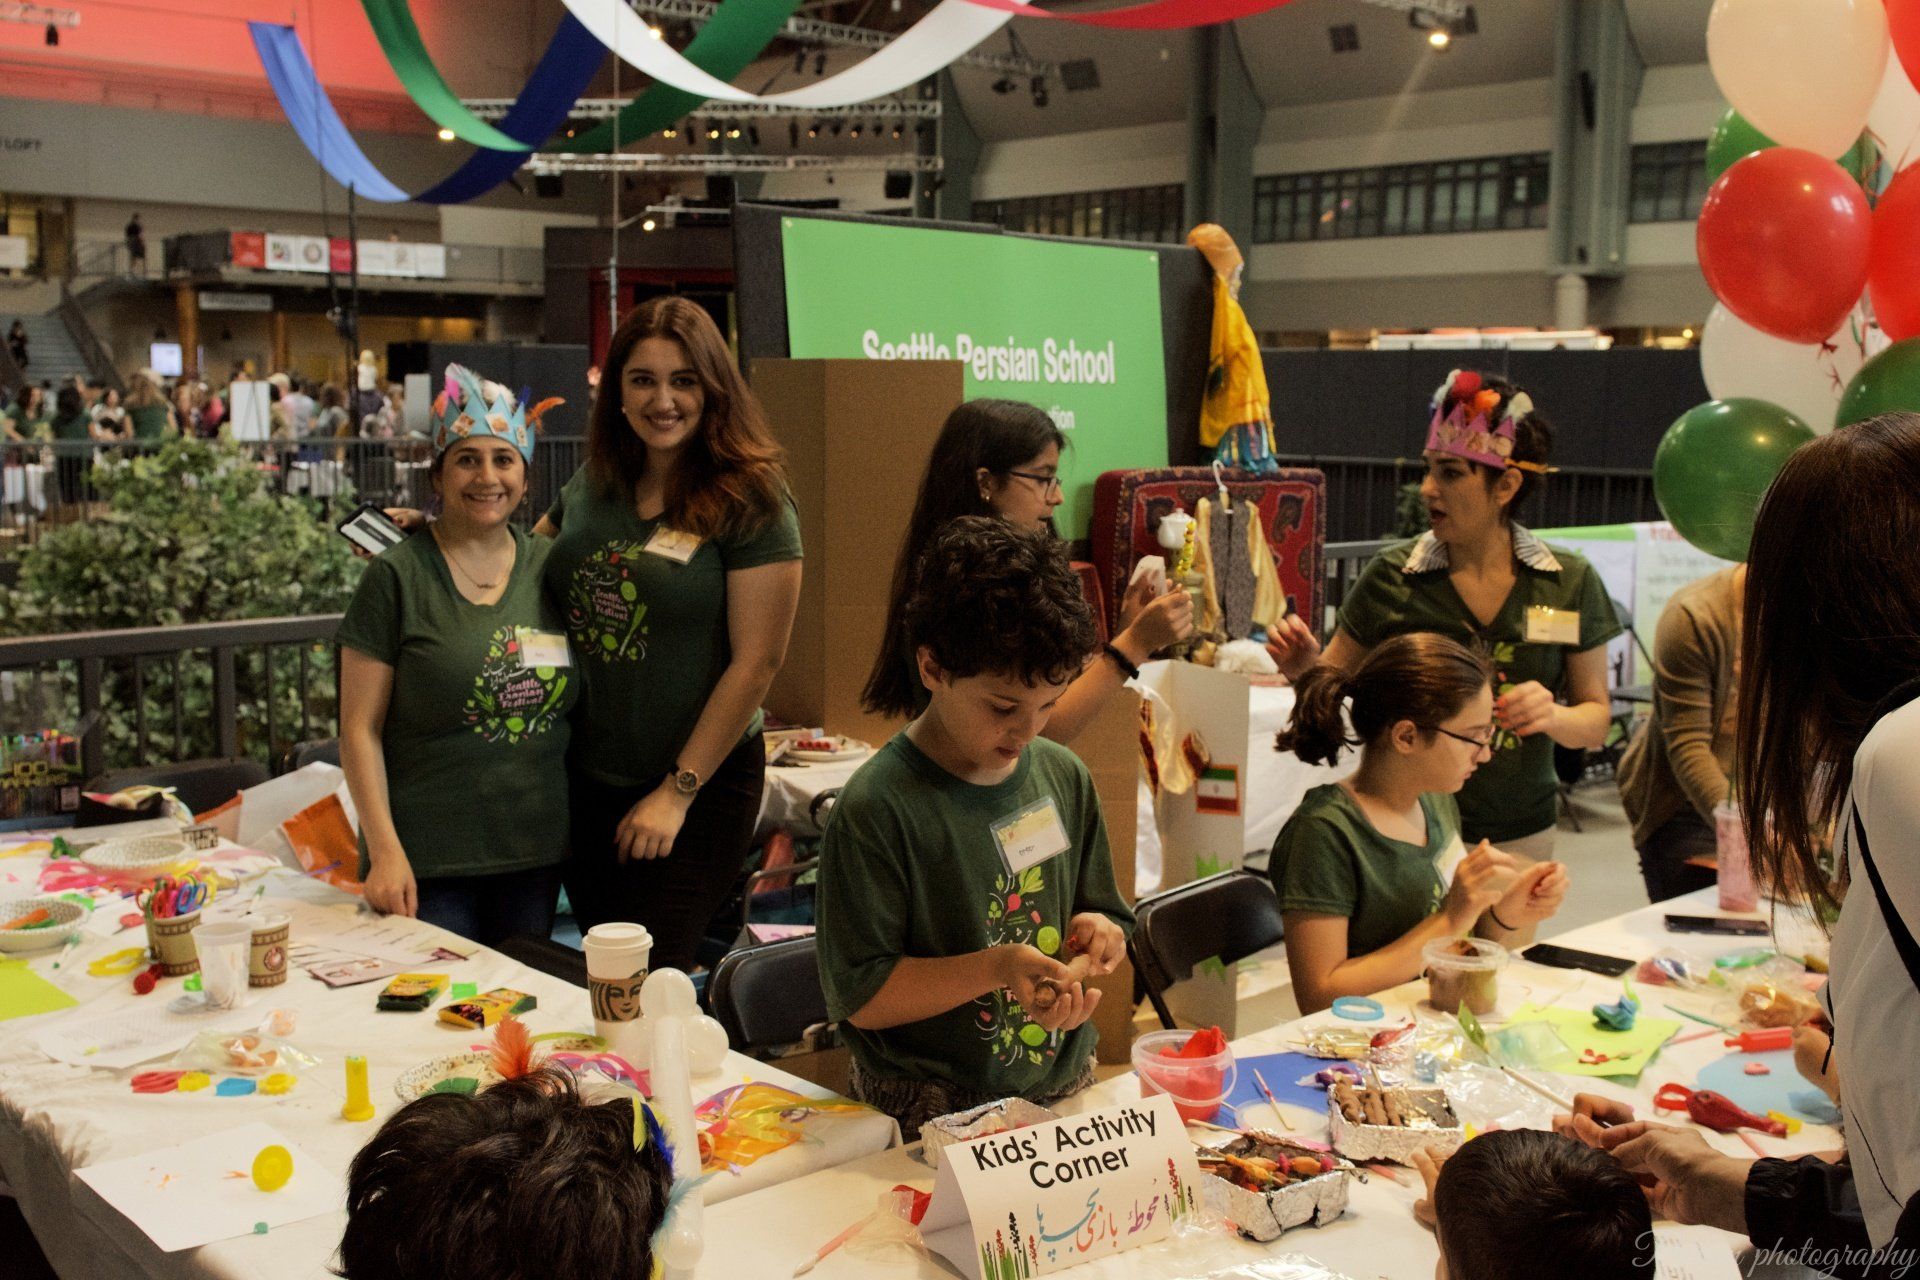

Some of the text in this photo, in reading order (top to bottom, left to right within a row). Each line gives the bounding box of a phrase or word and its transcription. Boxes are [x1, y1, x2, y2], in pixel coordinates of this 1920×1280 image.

[956, 333, 1040, 382] Persian
[1043, 337, 1116, 384] School
[1055, 1108, 1156, 1153] Activity
[1029, 1146, 1129, 1189] Corner
